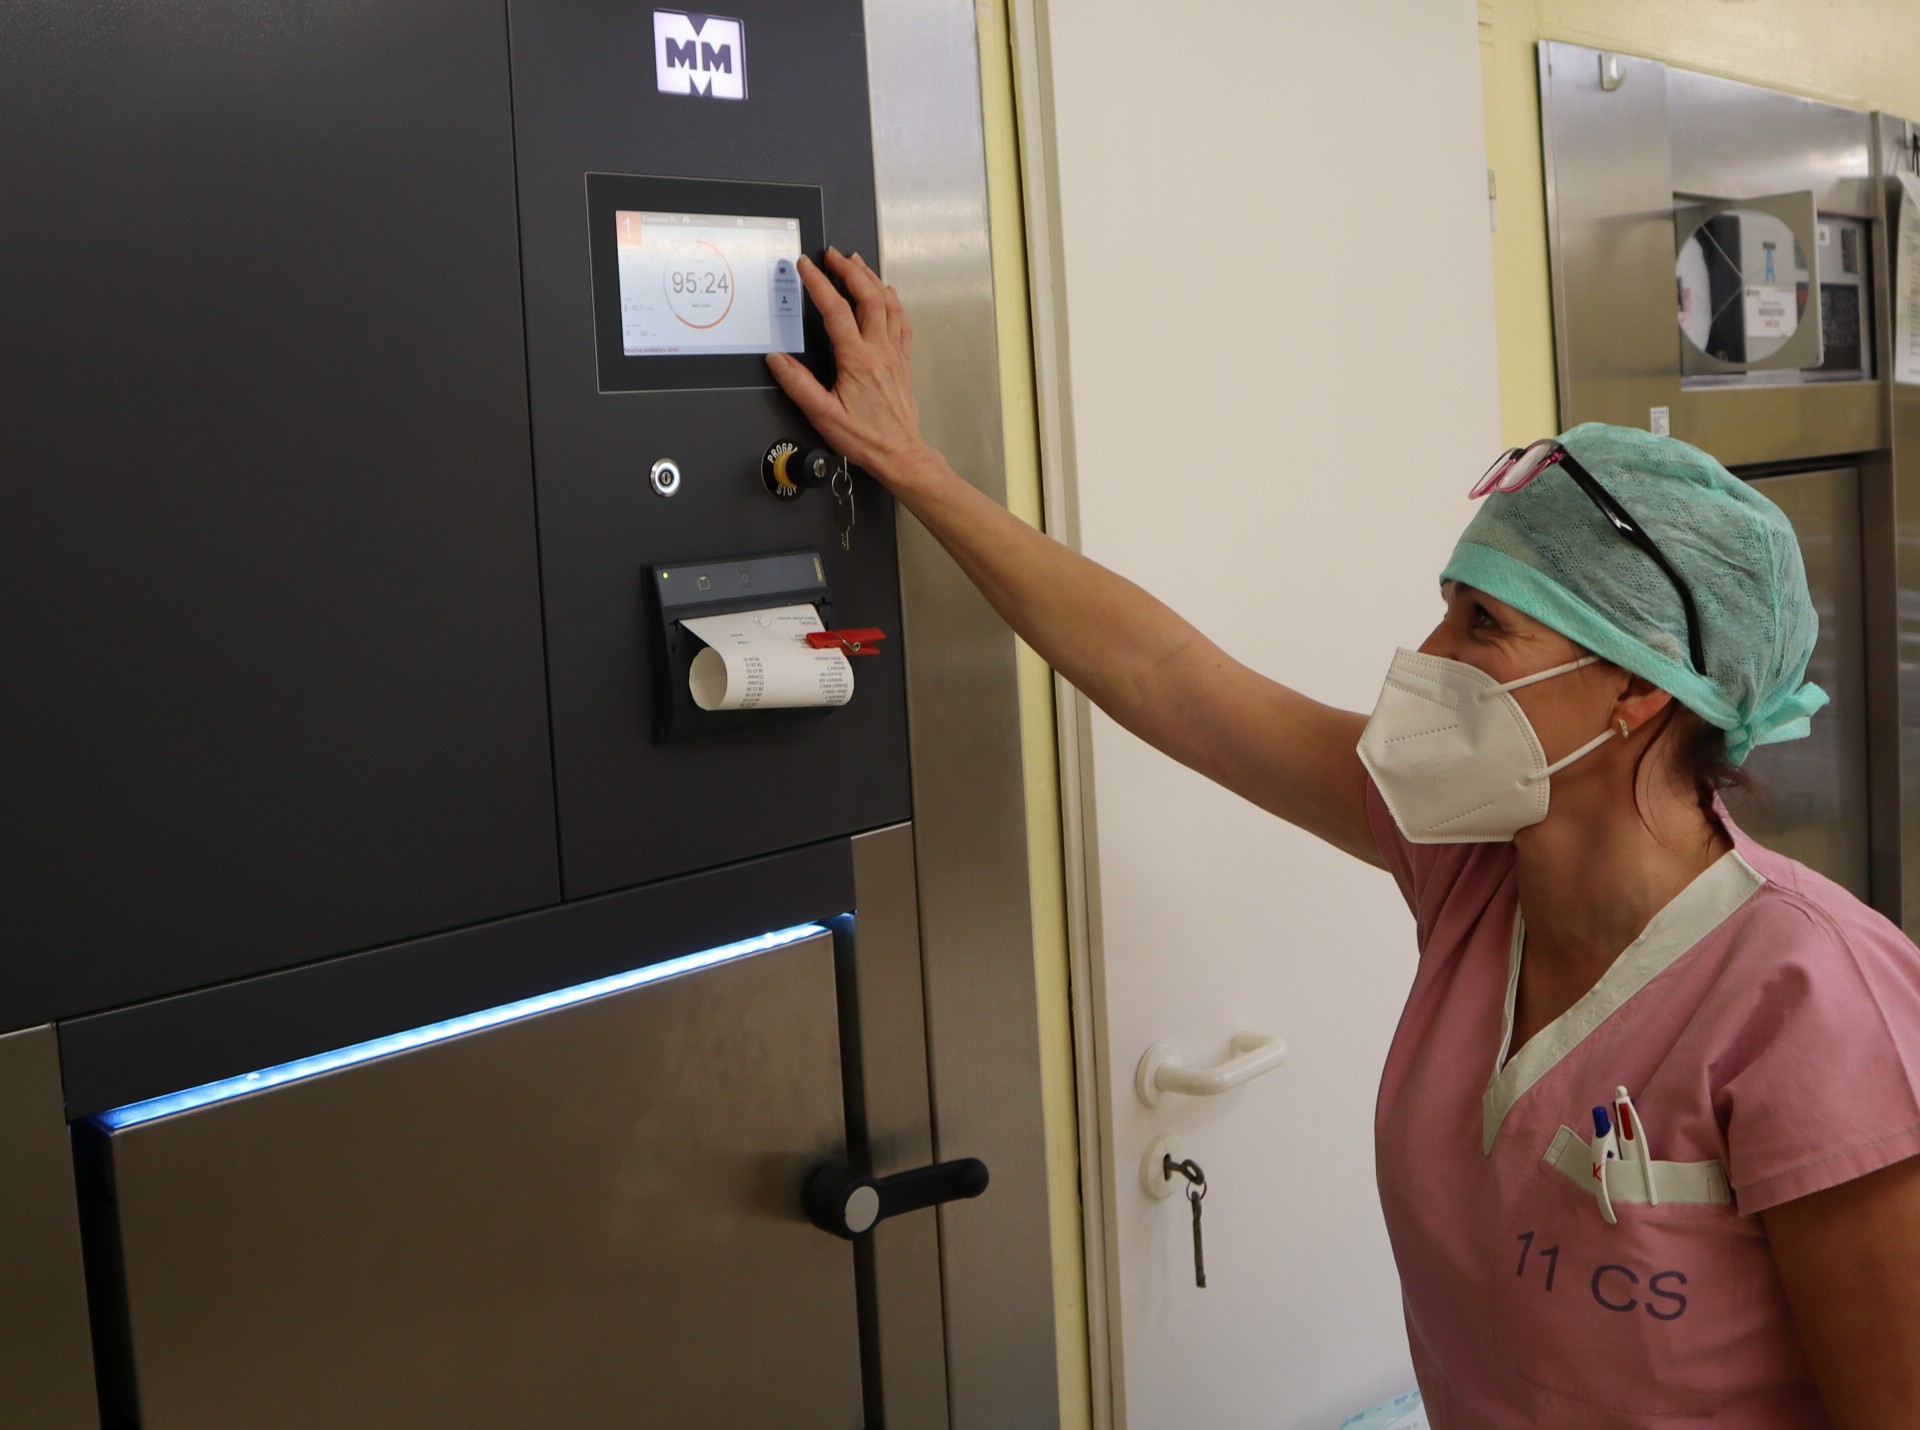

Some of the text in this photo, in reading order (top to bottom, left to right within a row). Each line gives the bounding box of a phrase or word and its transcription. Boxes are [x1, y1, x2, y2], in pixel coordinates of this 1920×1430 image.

[621, 217, 632, 241] 1
[672, 271, 729, 295] 95:24
[1515, 1230, 1688, 1321] 11 CS
